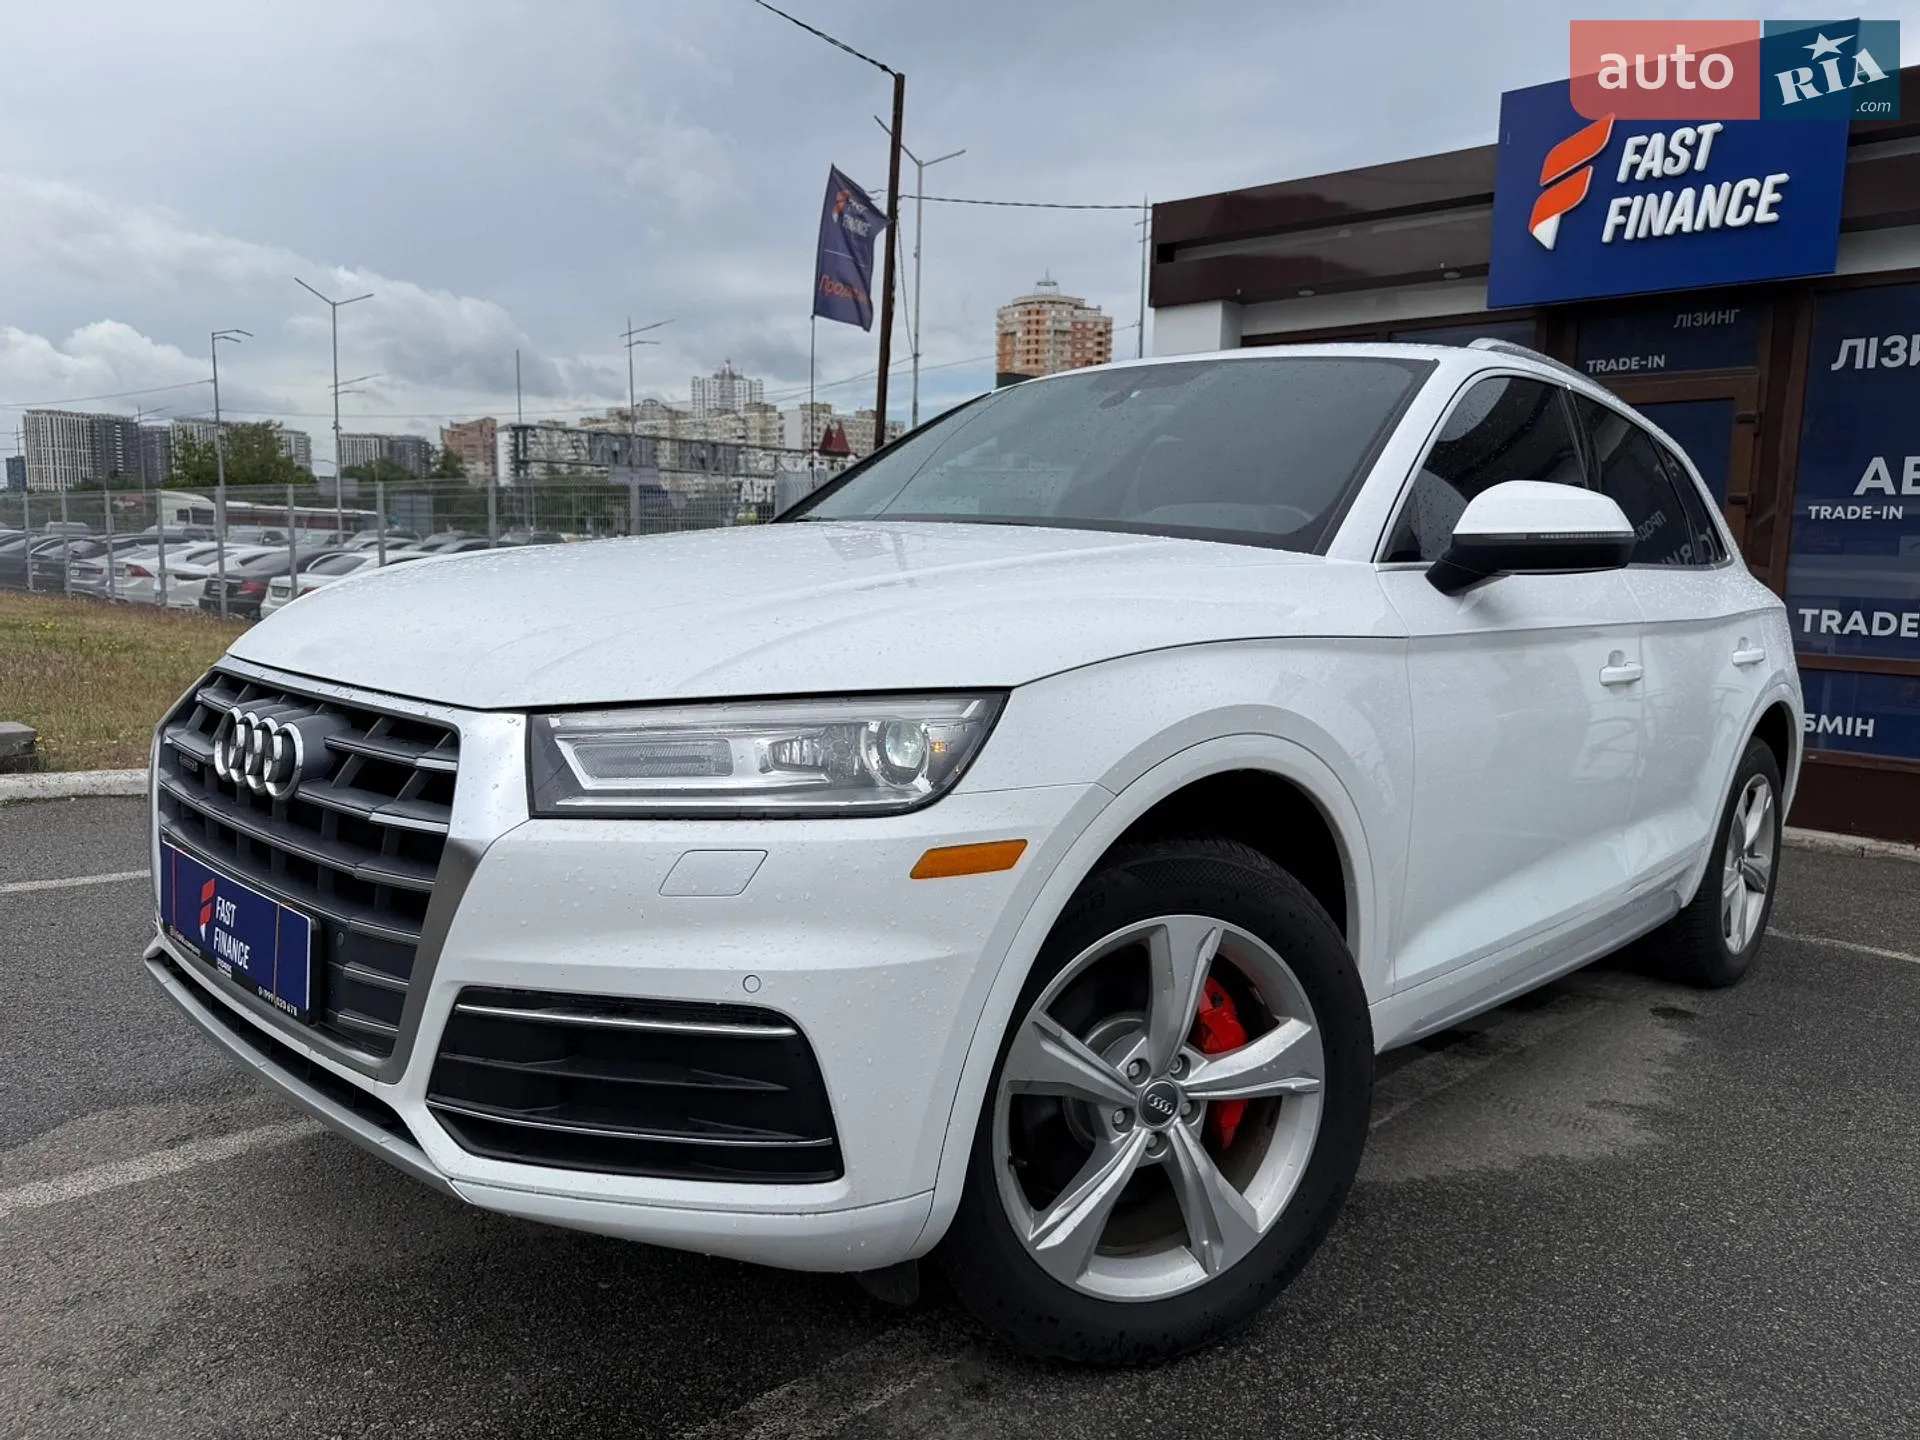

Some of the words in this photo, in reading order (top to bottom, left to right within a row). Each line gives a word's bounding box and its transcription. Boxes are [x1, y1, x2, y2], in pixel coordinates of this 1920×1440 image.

[1617, 122, 1723, 184] FAST
[1601, 173, 1789, 243] FINANCE
[1673, 309, 1740, 328] ЛІЗИНГ
[1586, 354, 1665, 373] TRADE-IN
[1808, 505, 1903, 520] TRADE-IN
[215, 895, 237, 928] FAST
[213, 926, 250, 970] FINANCE
